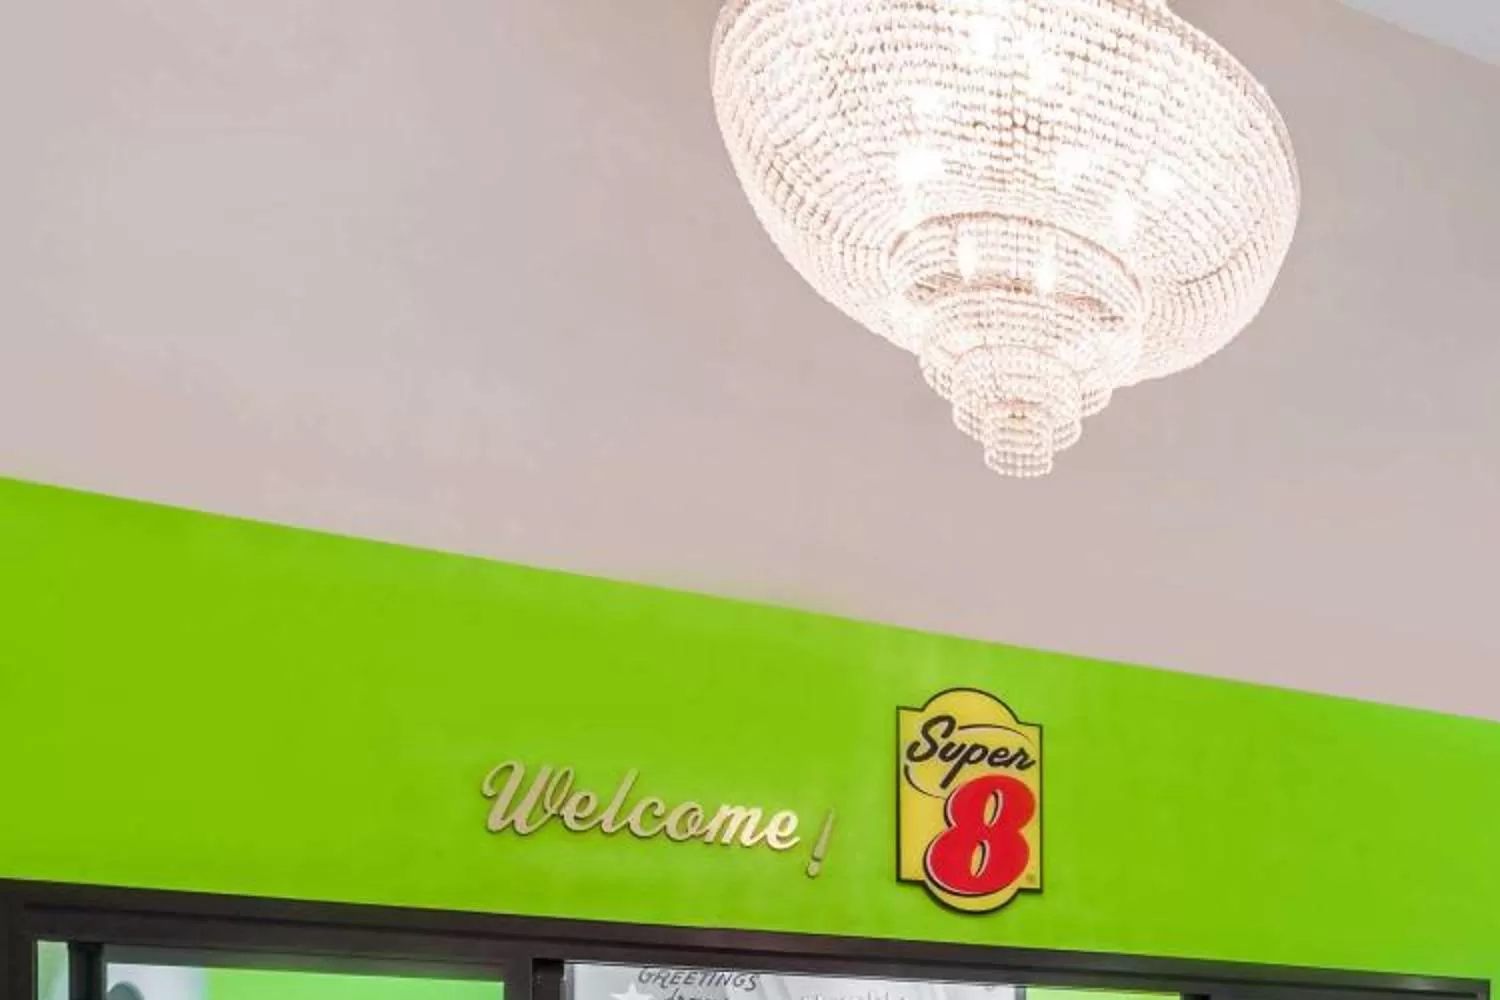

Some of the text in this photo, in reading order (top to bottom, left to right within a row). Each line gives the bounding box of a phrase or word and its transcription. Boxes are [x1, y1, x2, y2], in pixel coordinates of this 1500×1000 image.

[906, 714, 1036, 790] Super
[922, 774, 1037, 897] 8
[637, 967, 760, 992] GREETINGS
